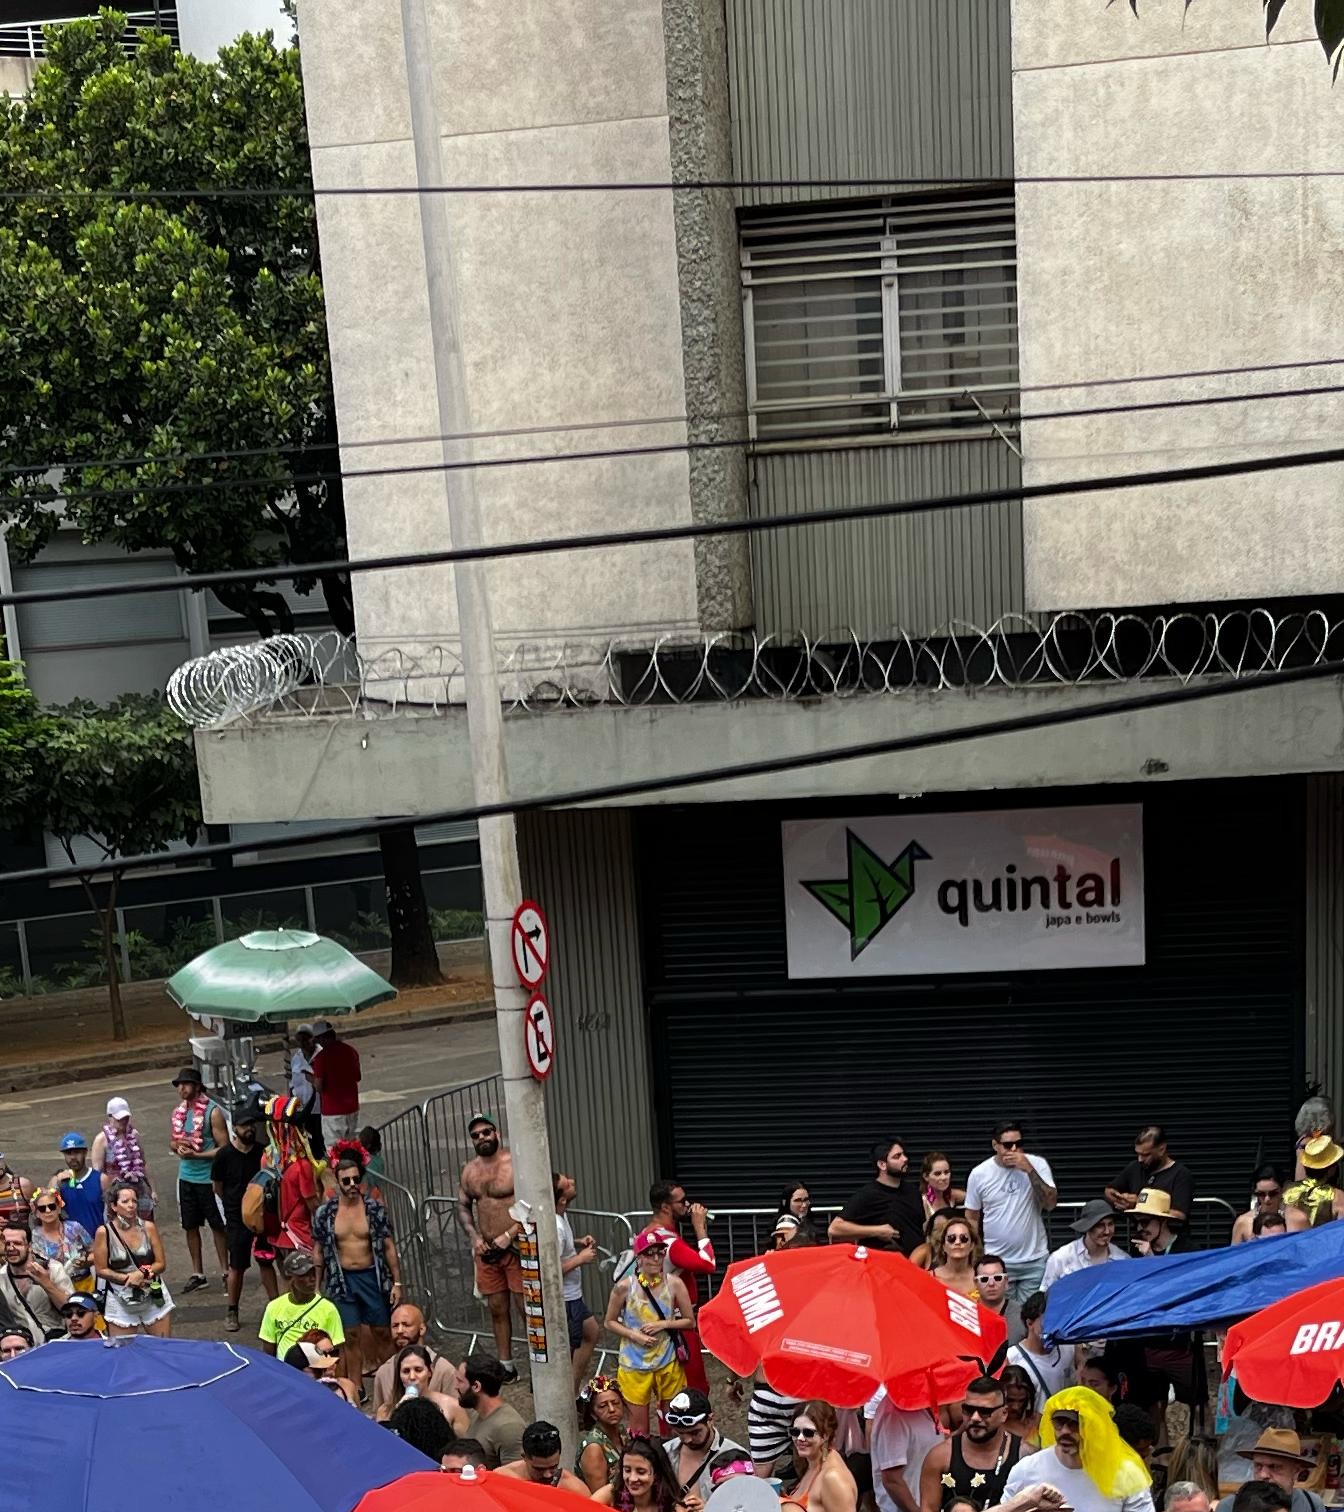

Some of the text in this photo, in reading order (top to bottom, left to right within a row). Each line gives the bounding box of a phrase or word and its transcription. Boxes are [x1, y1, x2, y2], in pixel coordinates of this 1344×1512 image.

[937, 858, 1121, 927] quintal
[1046, 911, 1120, 928] japa e bowls
